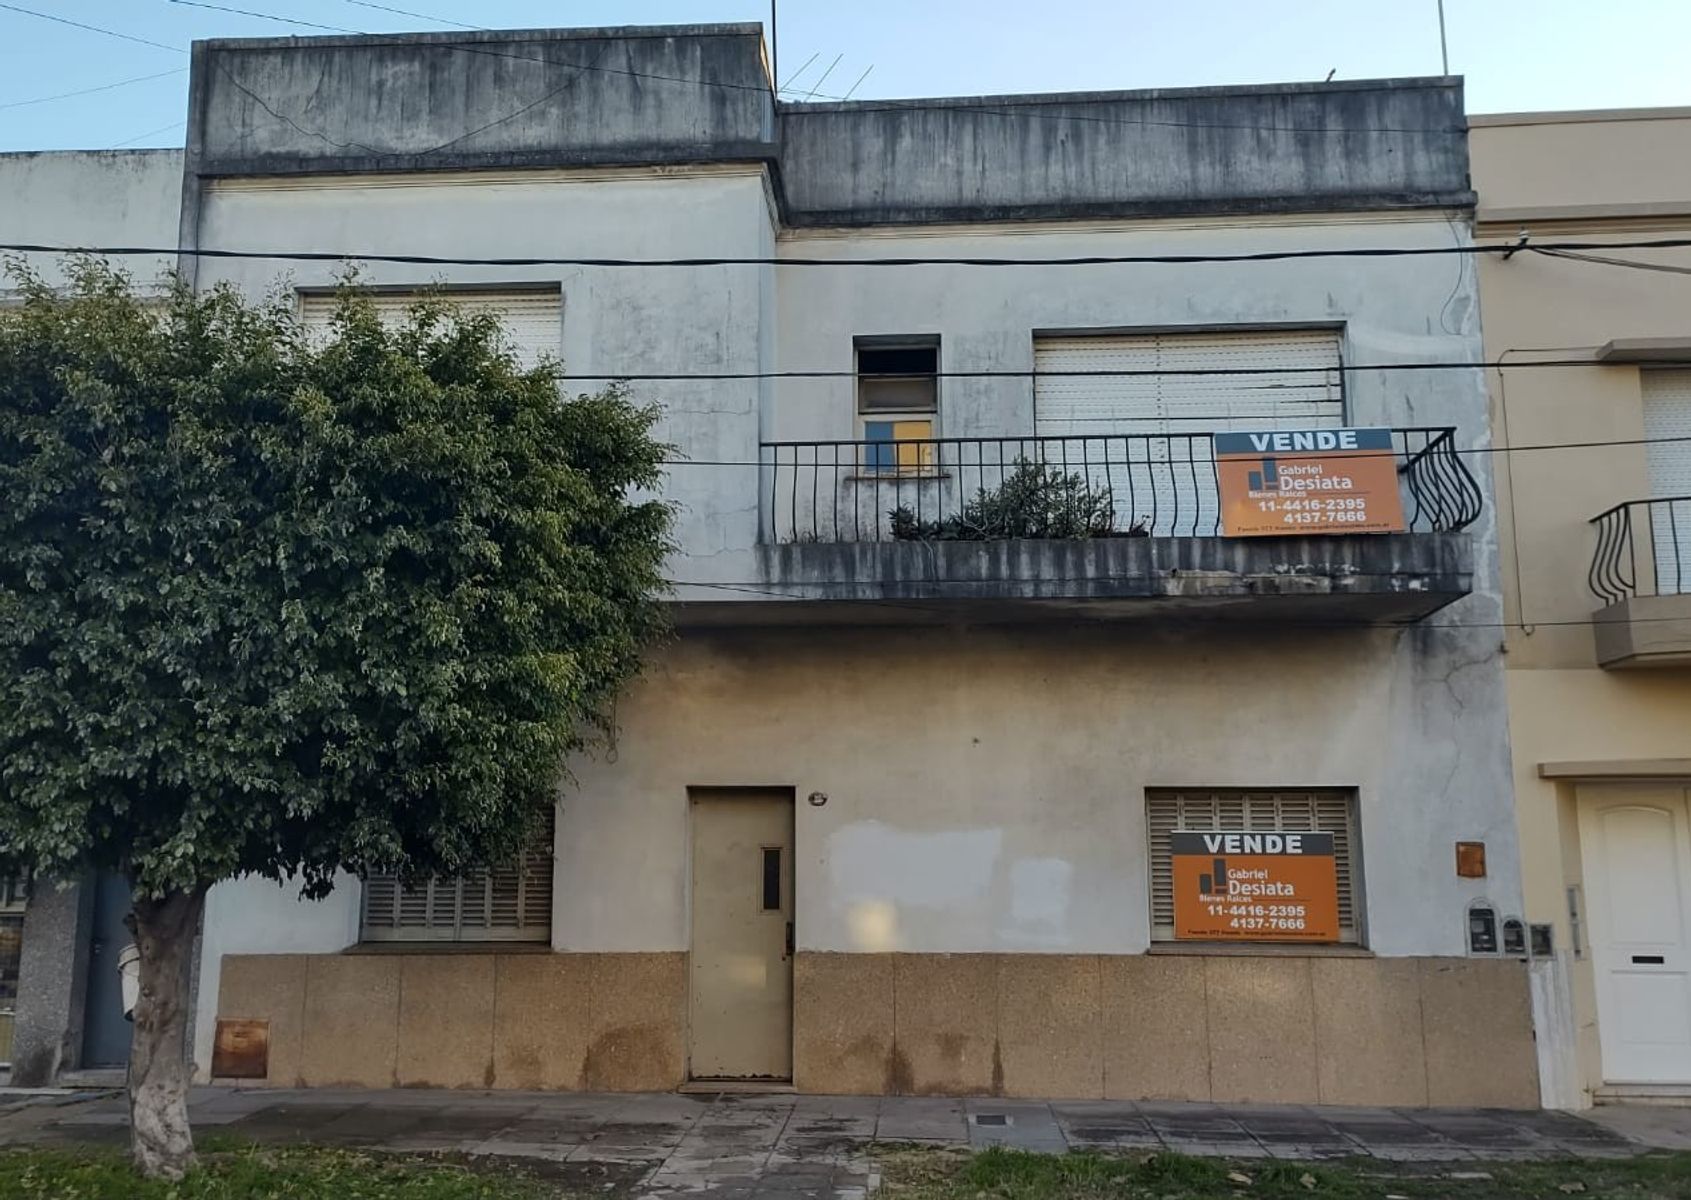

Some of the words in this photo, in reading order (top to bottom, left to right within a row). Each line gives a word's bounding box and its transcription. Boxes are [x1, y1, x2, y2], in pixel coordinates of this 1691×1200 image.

[1249, 431, 1358, 451] VENDE
[1279, 464, 1323, 475] Gabriel
[1280, 475, 1353, 491] Desiata
[1259, 498, 1365, 512] 11-4416-2395
[1283, 511, 1366, 523] 4137-7666
[1203, 834, 1303, 854] VENDE
[1228, 869, 1268, 879] Gabriel
[1229, 880, 1294, 896] Desiata
[1207, 905, 1305, 917] 11-4416-2395
[1230, 918, 1305, 930] 4137-7666
